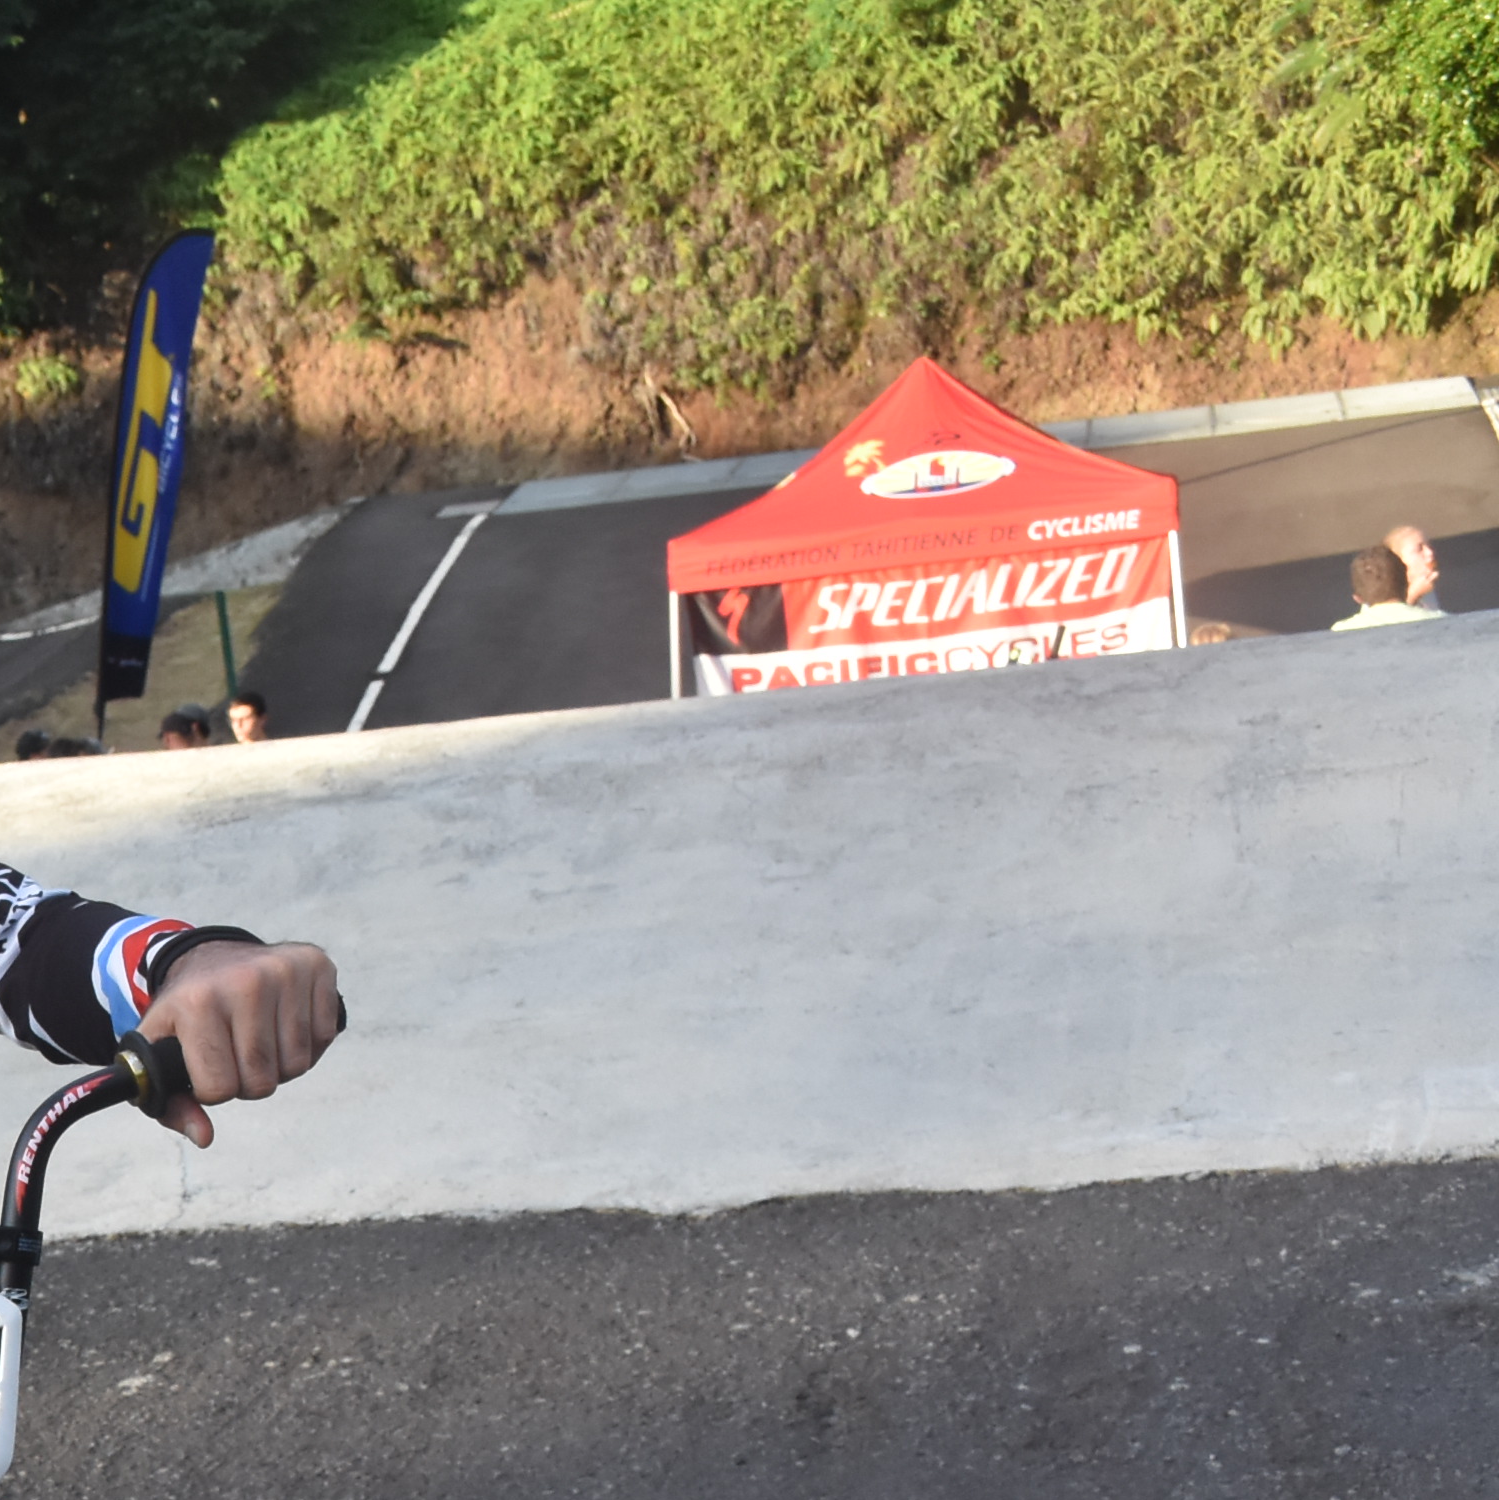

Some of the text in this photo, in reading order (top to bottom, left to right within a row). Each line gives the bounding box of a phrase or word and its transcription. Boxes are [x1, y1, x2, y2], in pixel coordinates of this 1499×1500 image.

[112, 288, 173, 594] GT
[852, 528, 978, 559] TAHITIENNE
[990, 525, 1017, 543] DE
[1026, 509, 1141, 541] CYCLISME
[808, 543, 1140, 635] SPECIALIZED
[17, 1085, 91, 1184] RENTHAL
